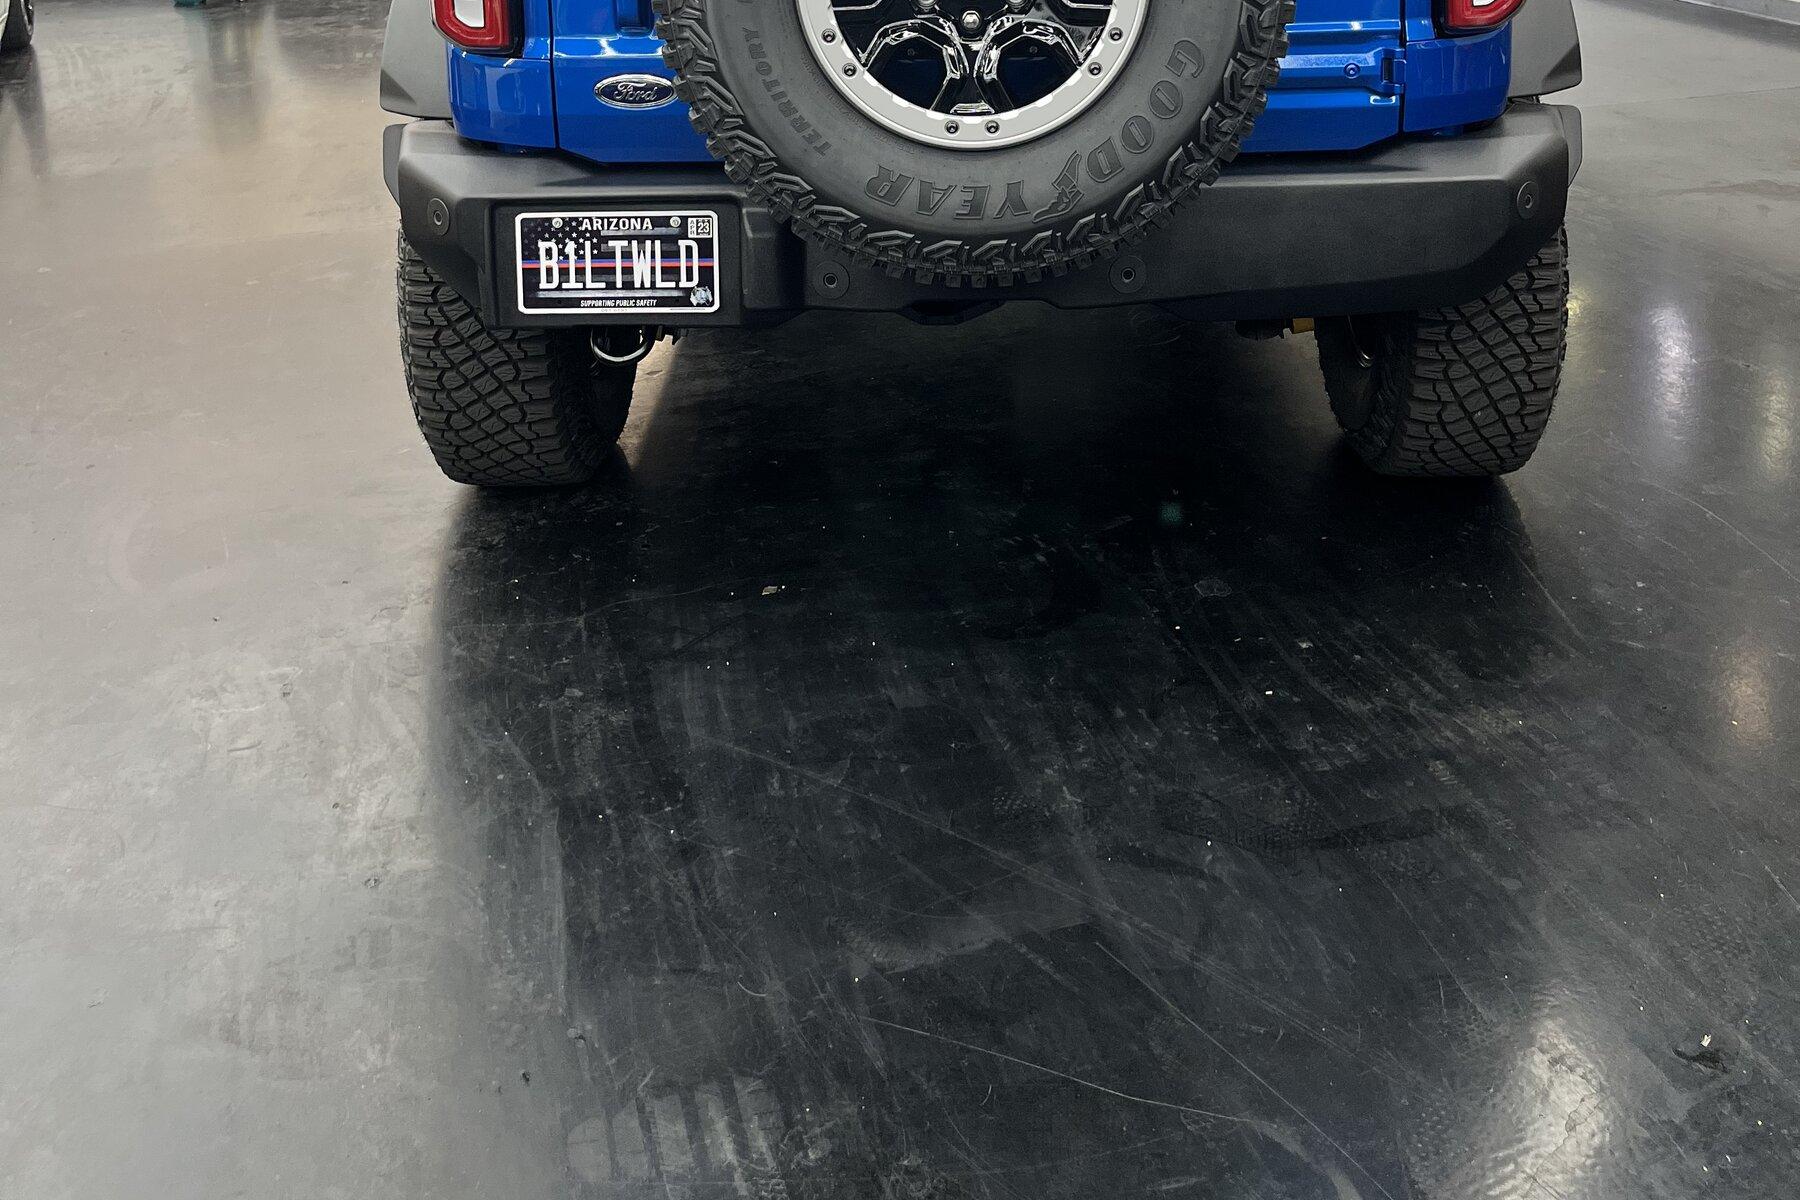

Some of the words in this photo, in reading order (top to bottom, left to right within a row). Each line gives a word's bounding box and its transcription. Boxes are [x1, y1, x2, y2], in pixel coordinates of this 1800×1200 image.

[613, 81, 659, 101] Ford
[742, 26, 833, 157] TERRITORY
[580, 217, 654, 231] ARIZONA
[697, 222, 710, 233] 23
[580, 299, 615, 308] SUPPORTING
[615, 299, 636, 307] PUBLIC
[636, 299, 658, 307] SAFETY
